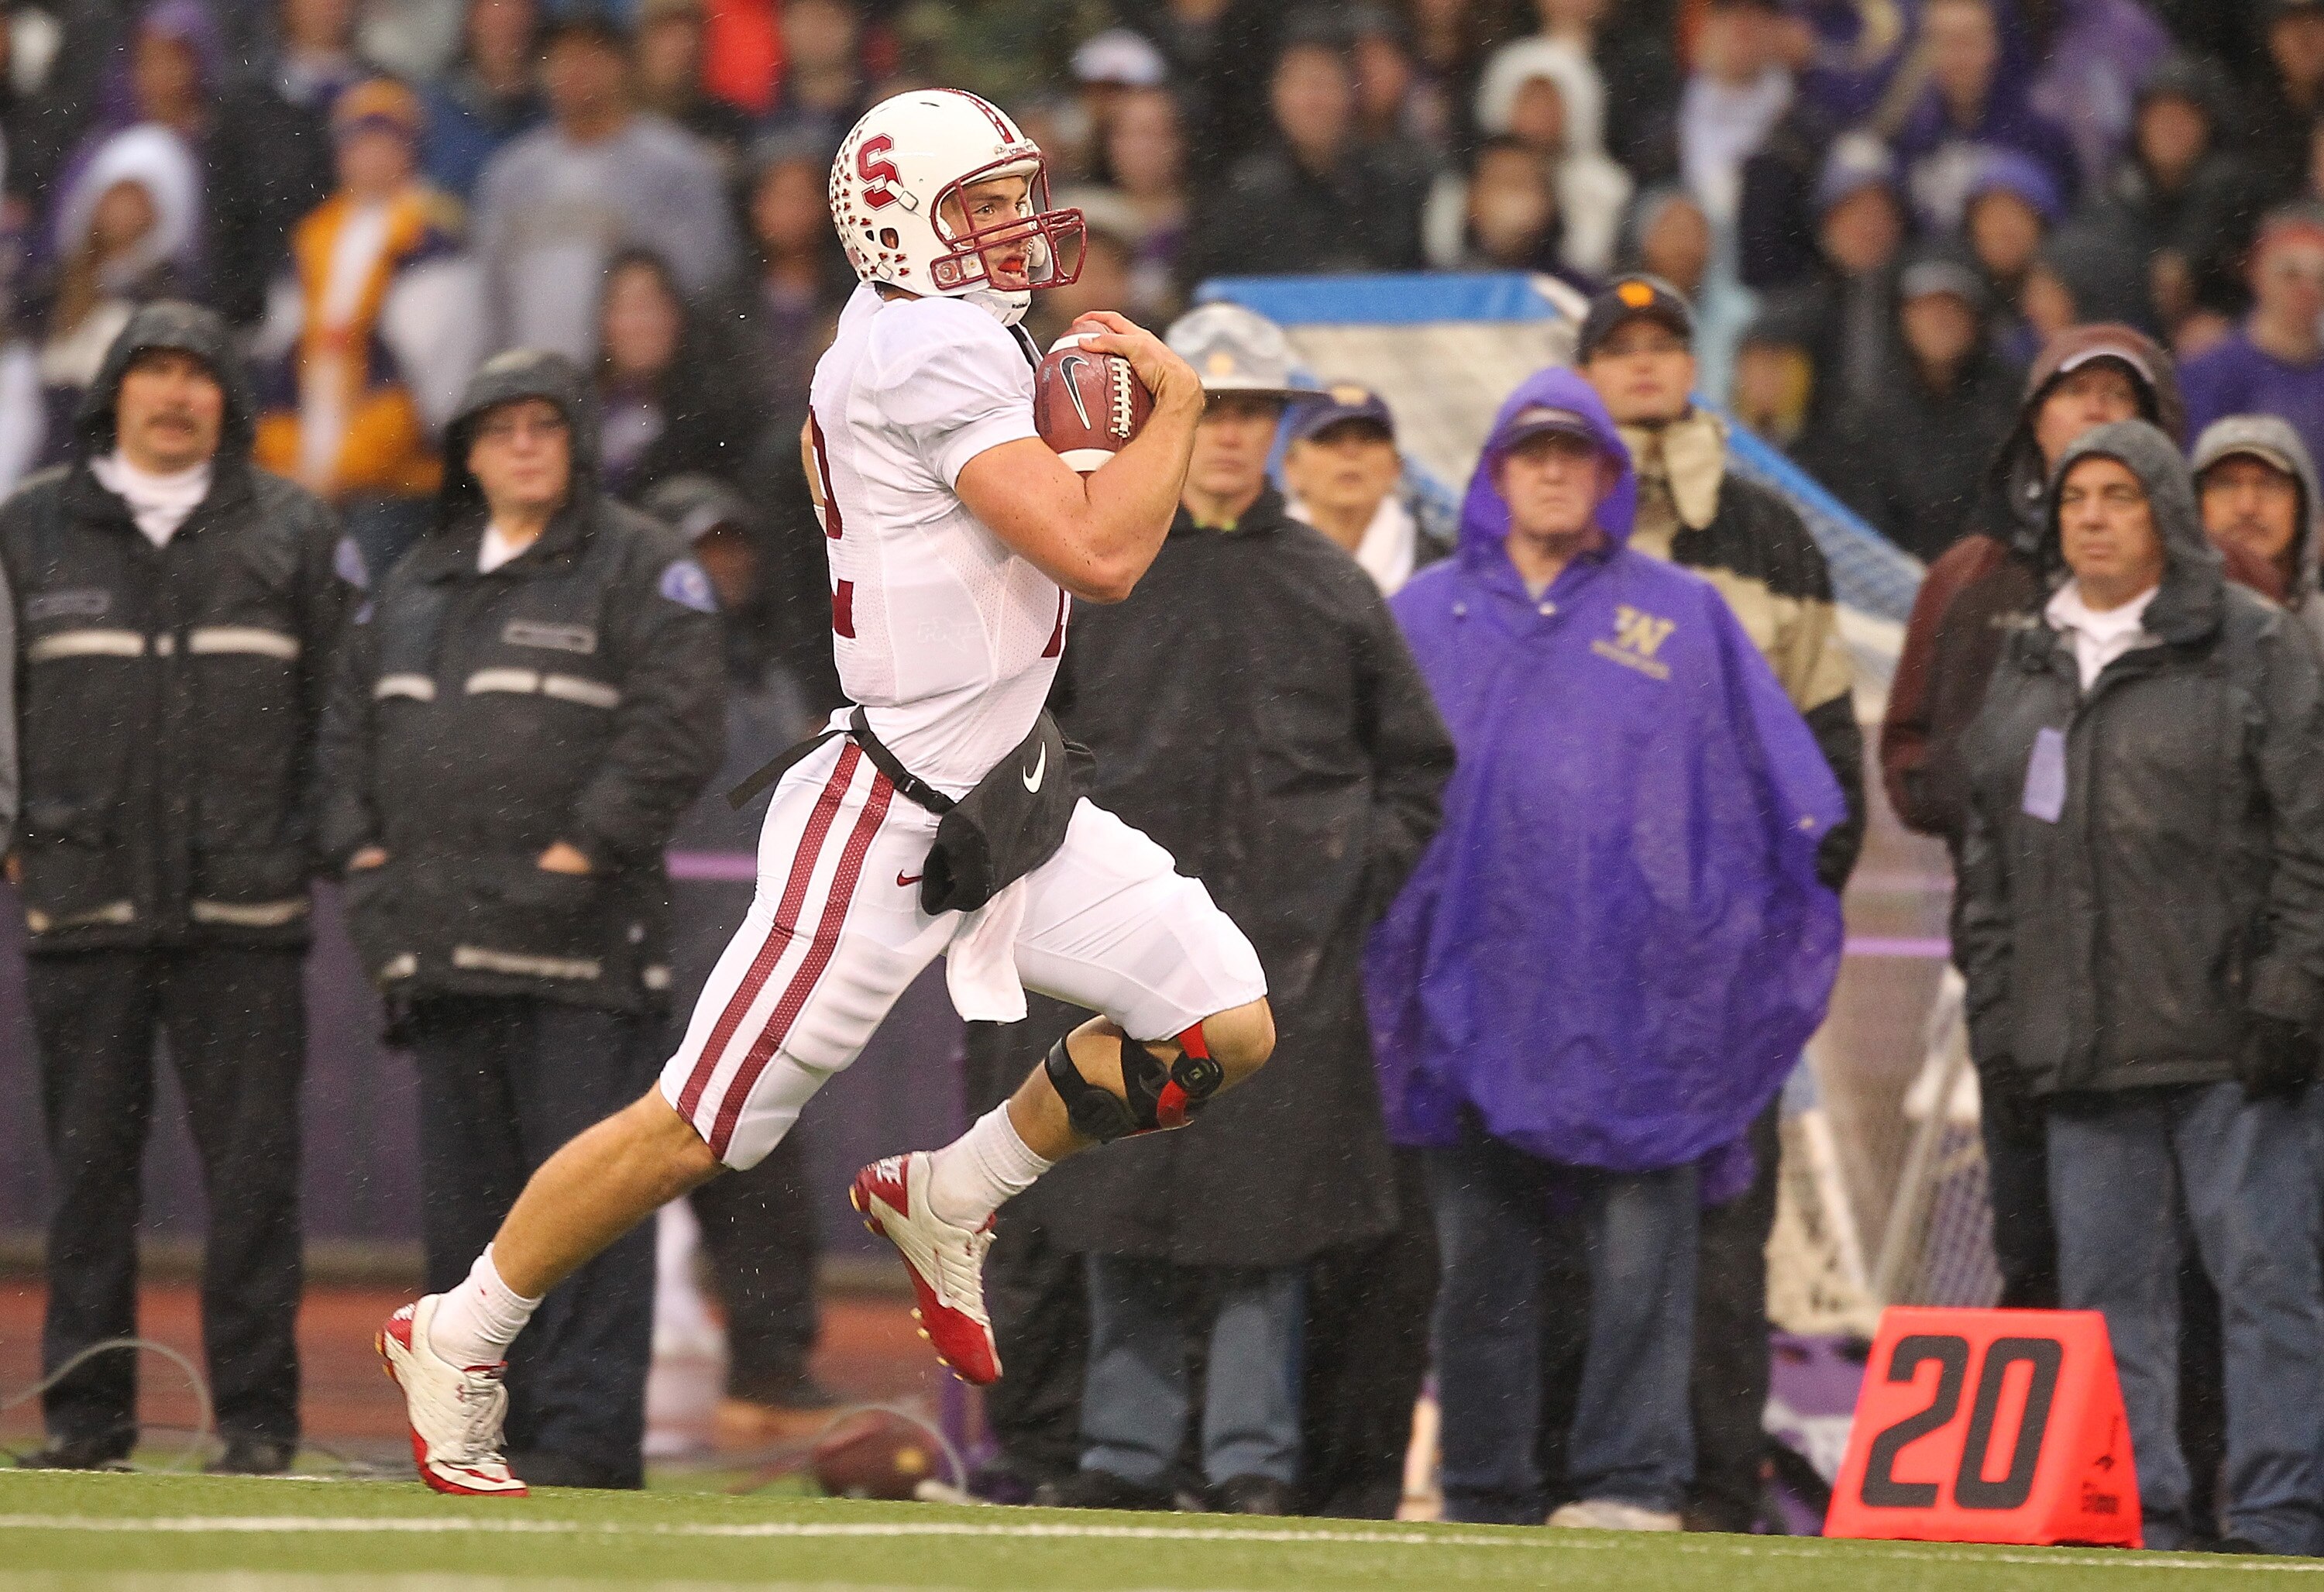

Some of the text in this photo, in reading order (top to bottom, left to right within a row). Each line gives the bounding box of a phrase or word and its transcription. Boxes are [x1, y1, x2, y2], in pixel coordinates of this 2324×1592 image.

[856, 133, 904, 211] S
[1614, 605, 1675, 655] W
[1860, 1334, 2064, 1510] 20
